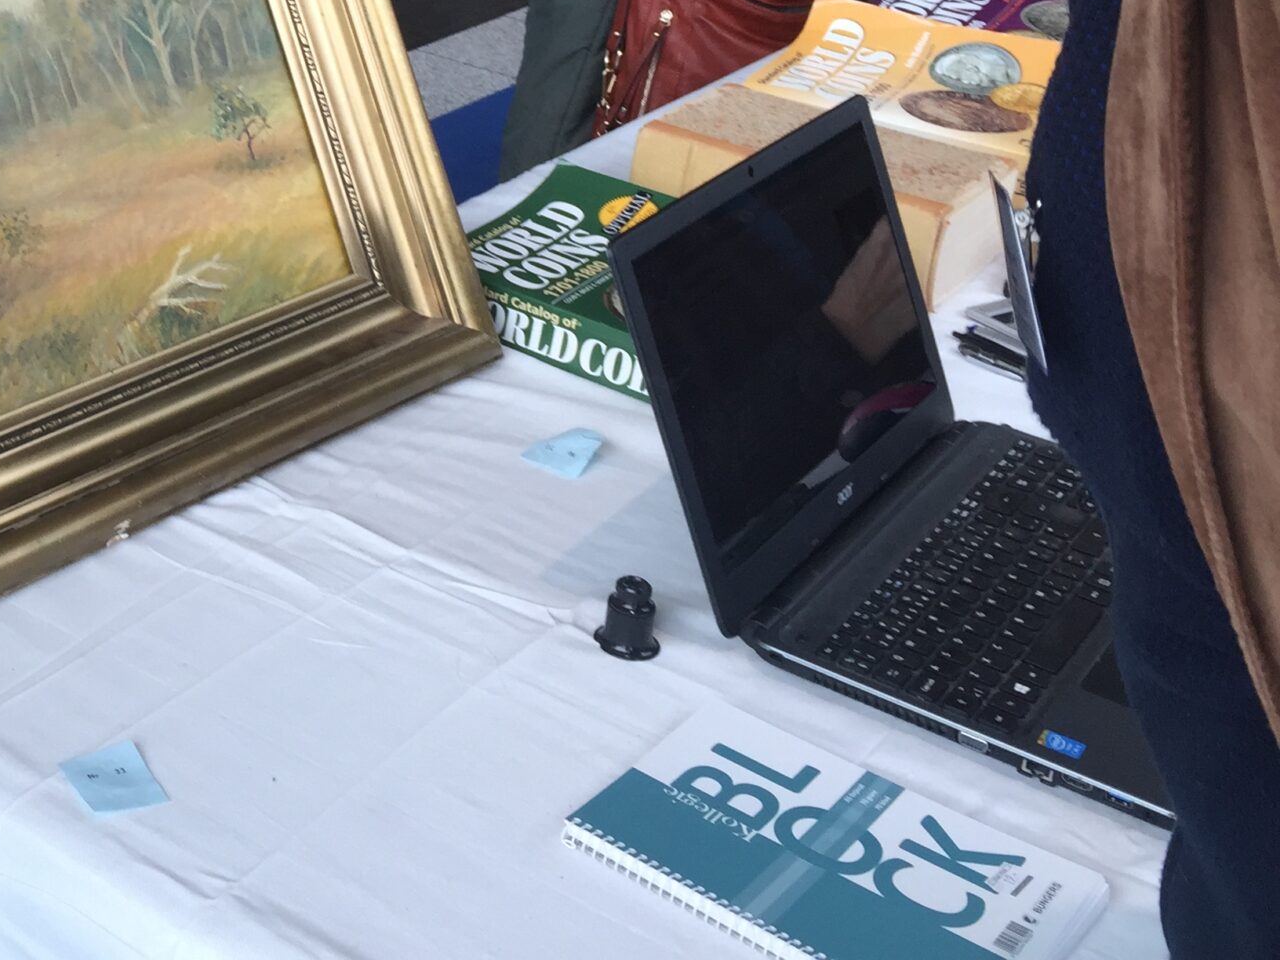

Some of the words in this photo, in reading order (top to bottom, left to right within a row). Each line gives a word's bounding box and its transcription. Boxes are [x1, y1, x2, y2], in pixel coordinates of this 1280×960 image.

[771, 18, 865, 92] WORLD
[470, 200, 585, 274] WORLD
[602, 191, 652, 236] OFFICIAL
[502, 228, 610, 290] COINS
[543, 260, 609, 298] 1701-1800
[510, 296, 561, 327] Catalog
[487, 300, 579, 365] ORLD
[579, 338, 649, 397] COI
[663, 785, 760, 843] Kollegie
